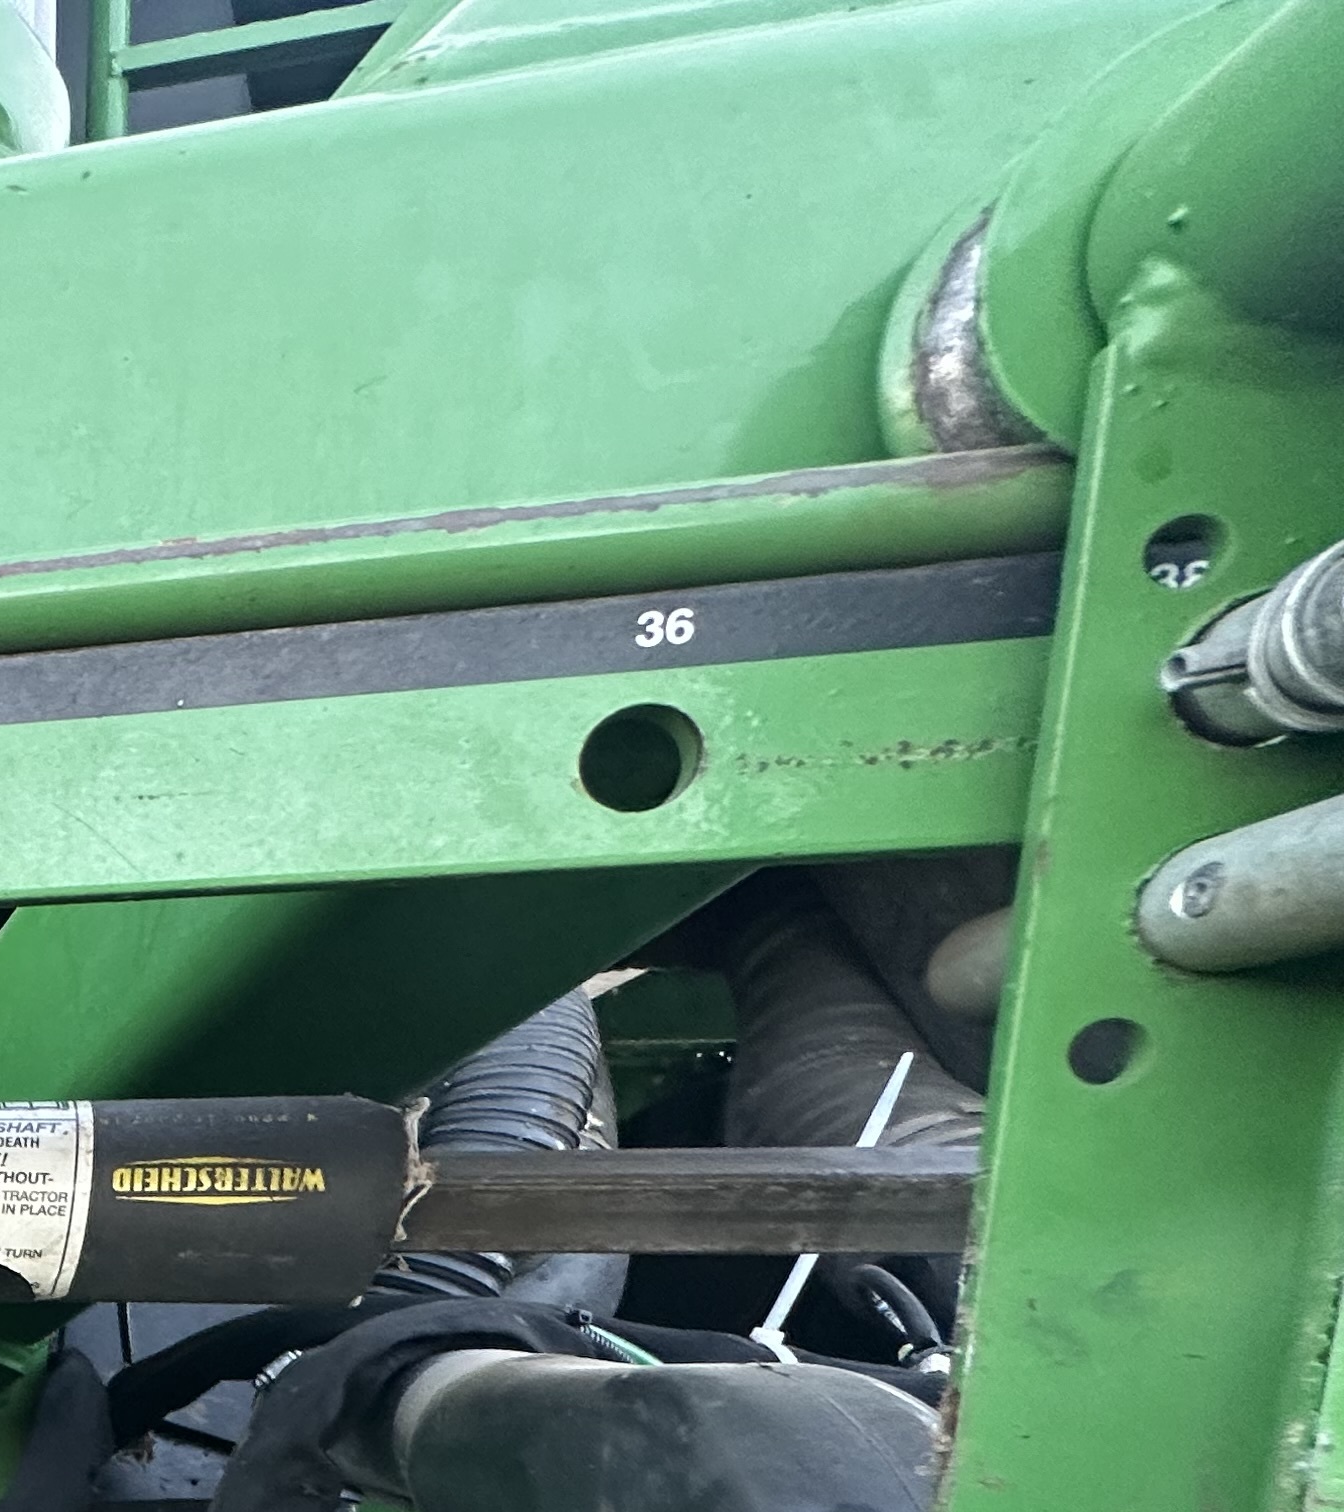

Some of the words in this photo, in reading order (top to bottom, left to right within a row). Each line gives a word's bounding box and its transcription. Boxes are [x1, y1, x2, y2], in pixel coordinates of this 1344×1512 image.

[634, 607, 695, 648] 36
[112, 1166, 326, 1192] WALTERSCHEID
[2, 1189, 68, 1203] TRACTOR
[2, 1203, 16, 1215] IN
[20, 1204, 67, 1217] PLACE
[5, 1247, 43, 1259] TURN
